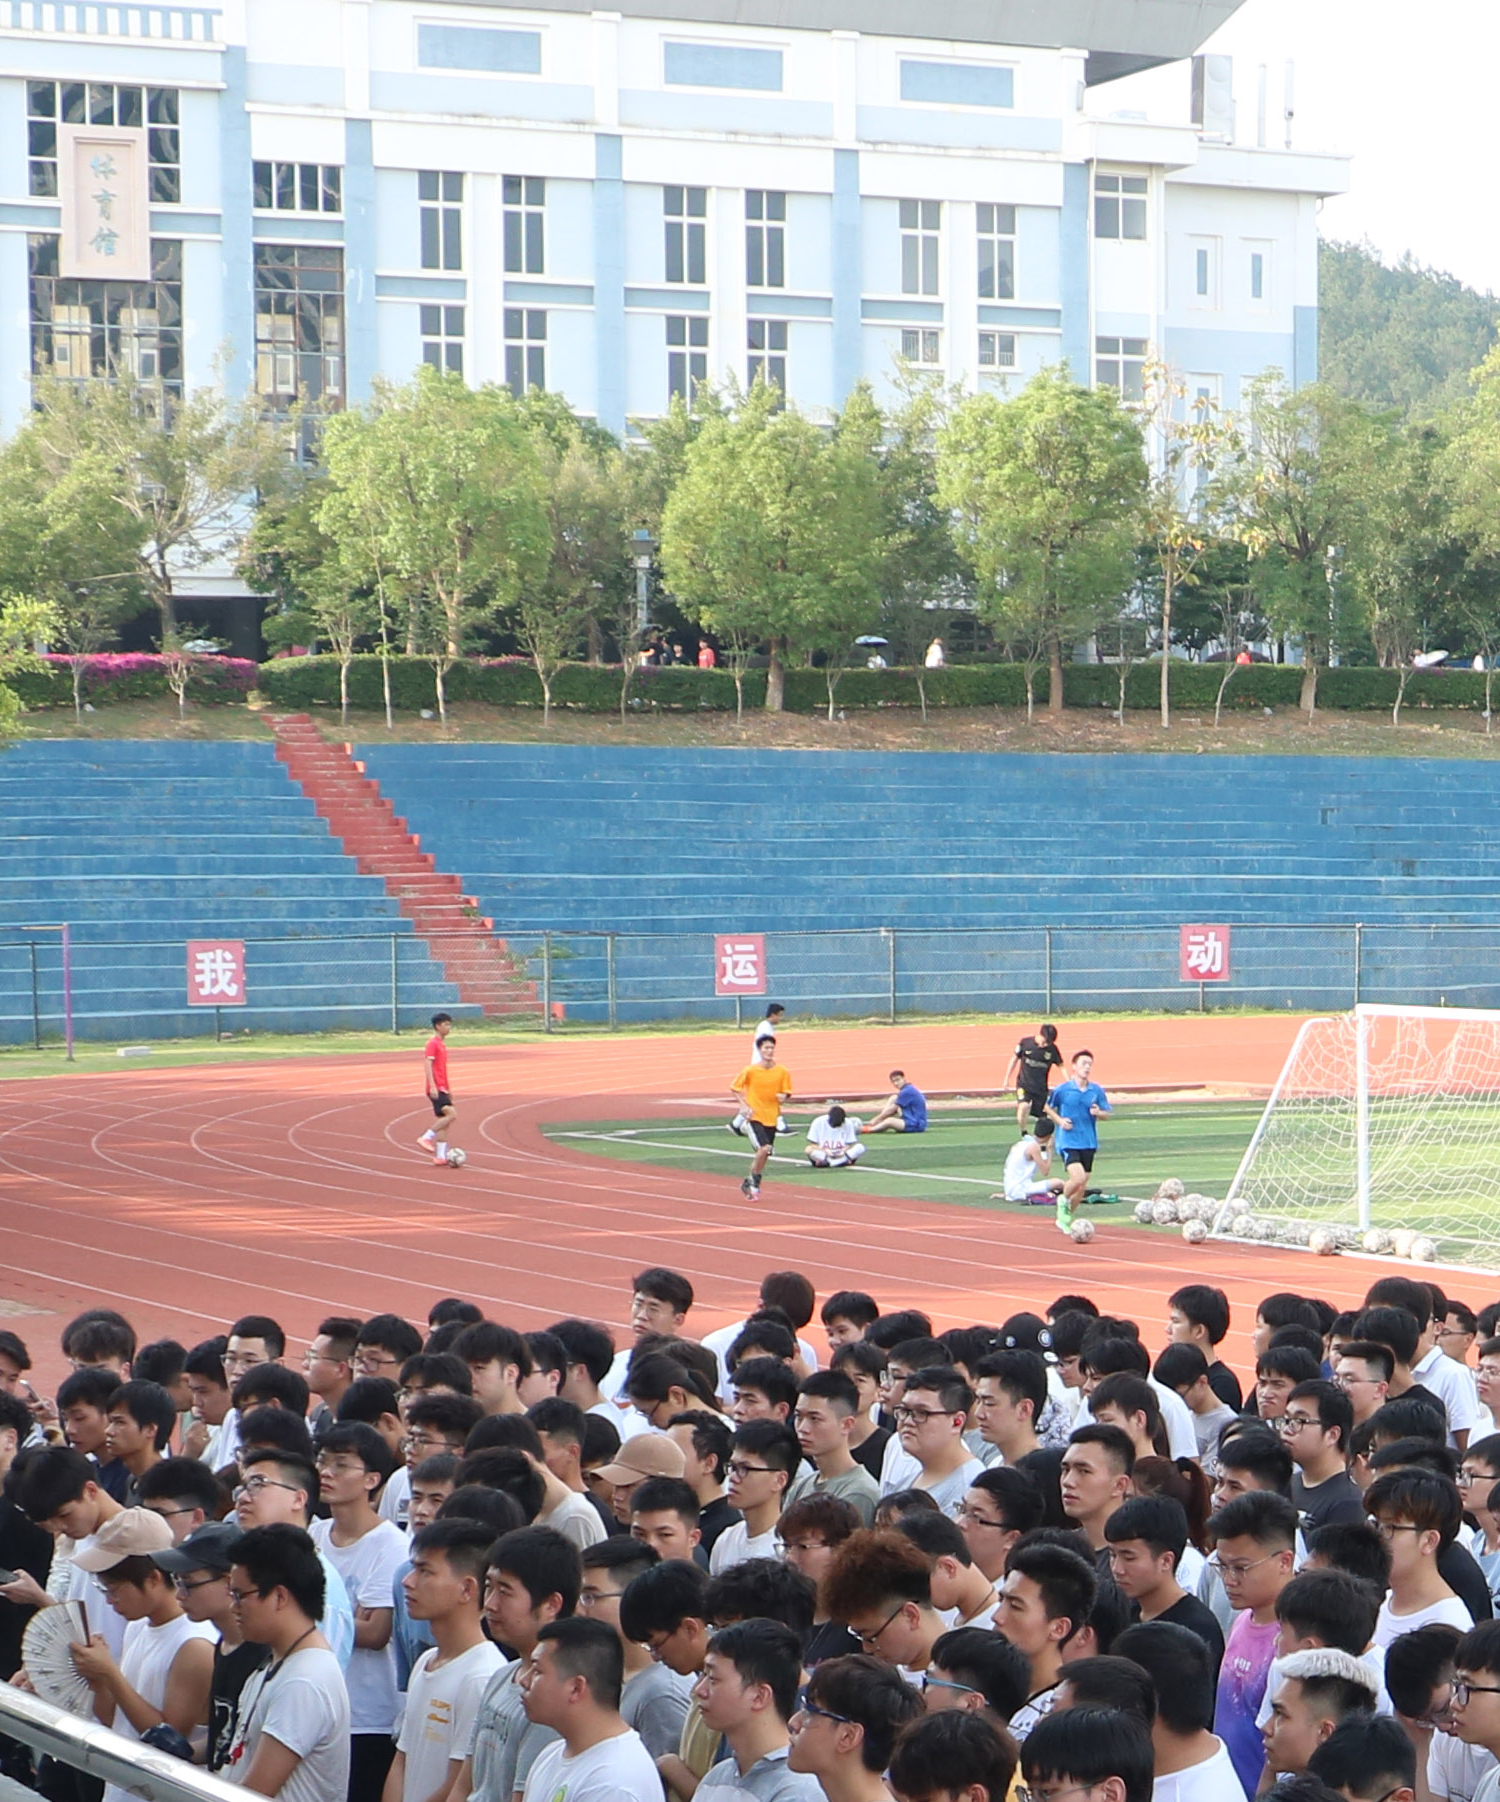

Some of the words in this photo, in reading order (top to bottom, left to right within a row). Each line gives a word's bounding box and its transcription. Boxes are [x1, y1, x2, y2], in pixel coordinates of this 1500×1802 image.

[195, 949, 238, 997] 我
[722, 944, 759, 985] 运
[1187, 932, 1223, 974] 动
